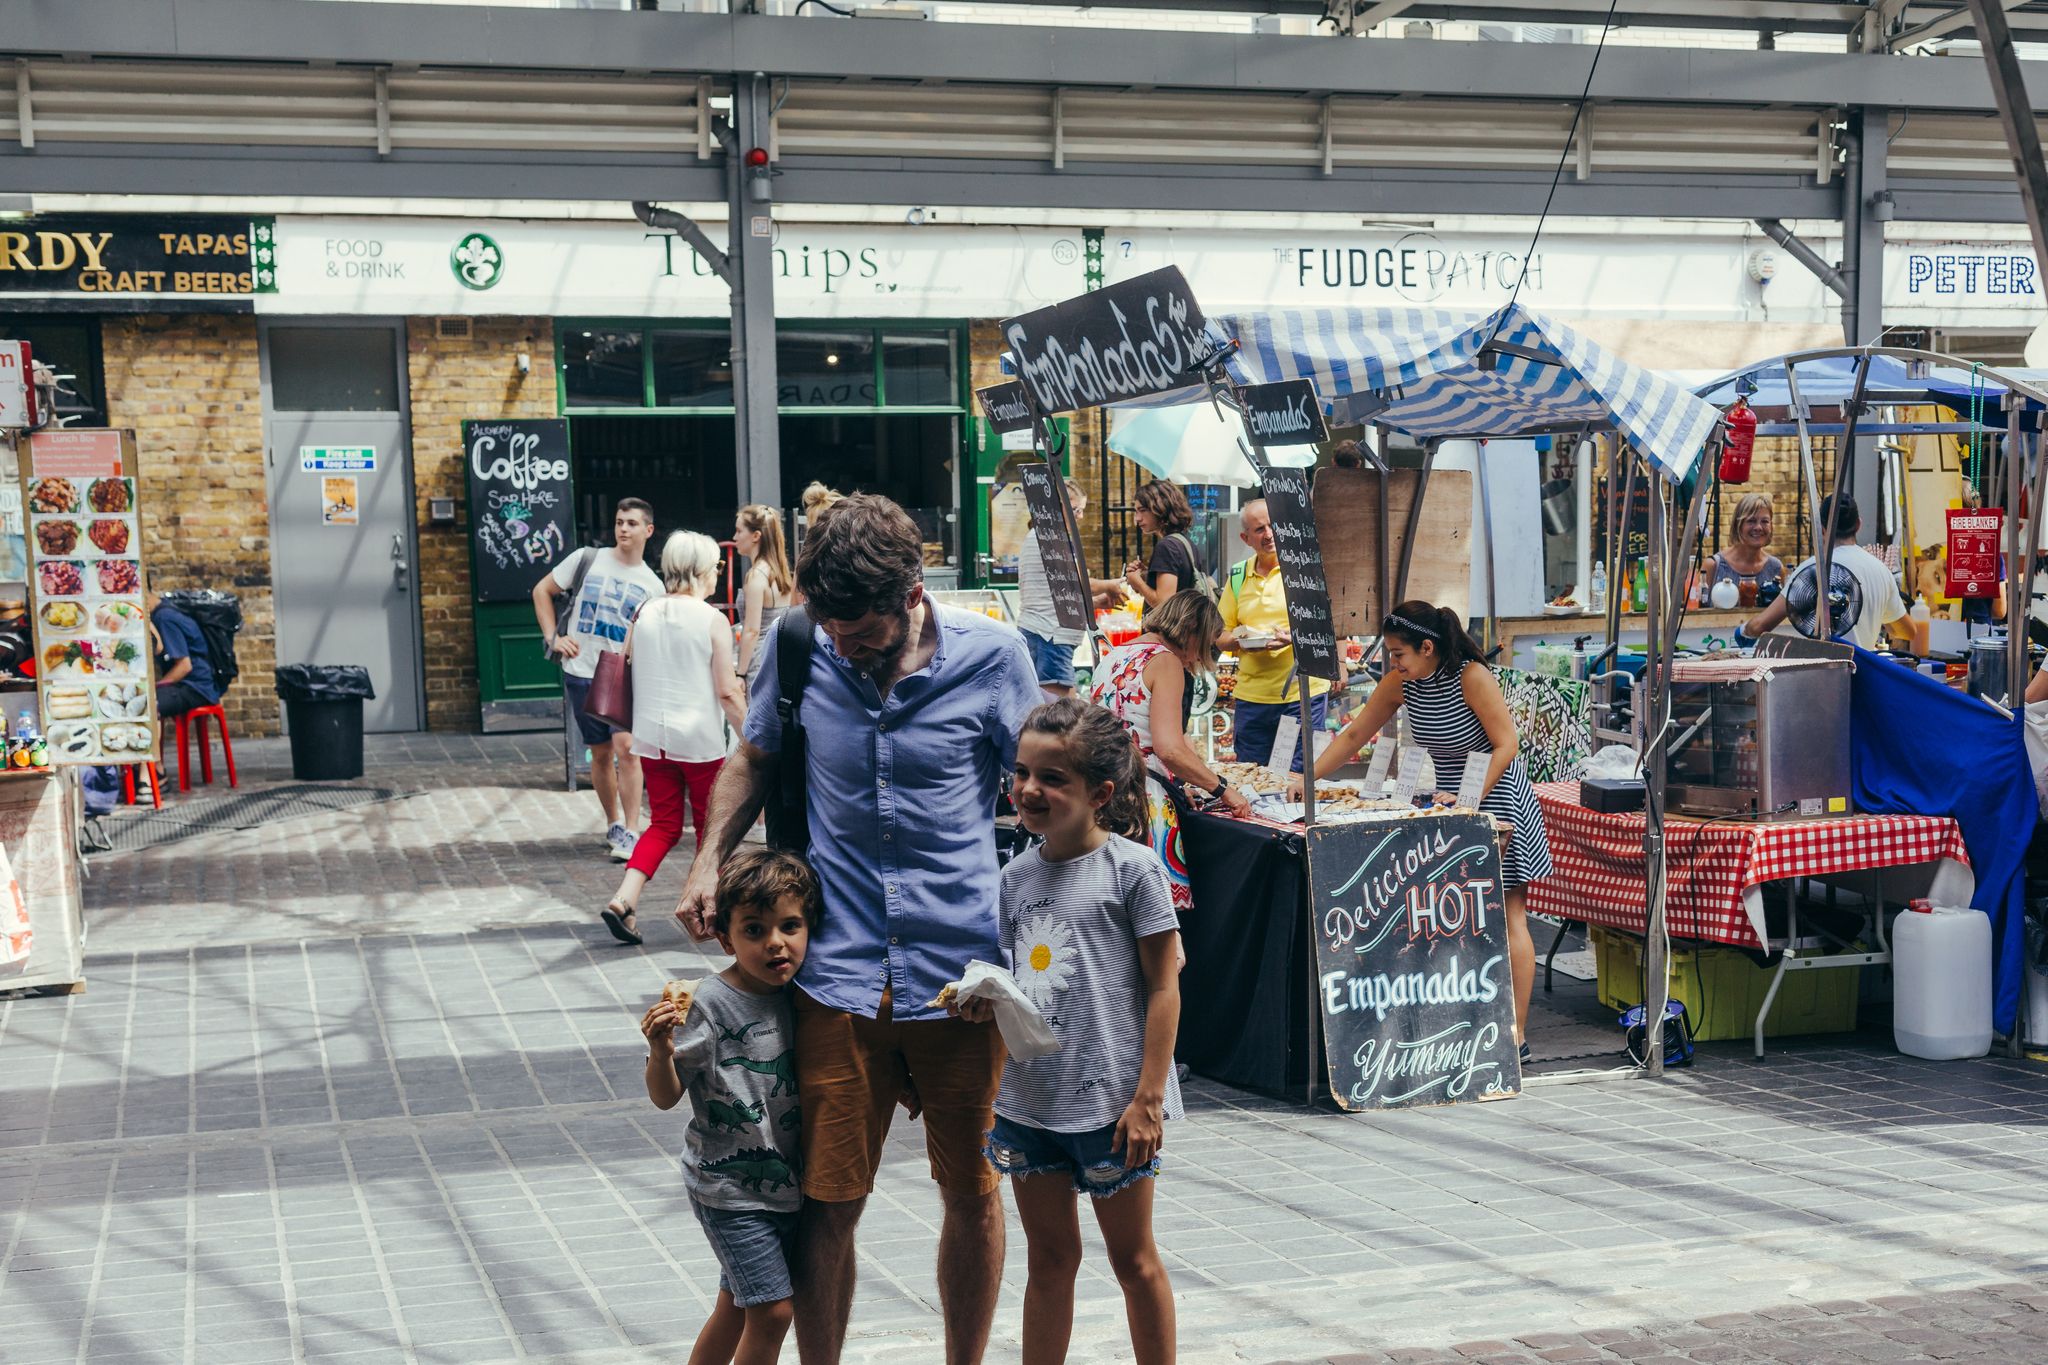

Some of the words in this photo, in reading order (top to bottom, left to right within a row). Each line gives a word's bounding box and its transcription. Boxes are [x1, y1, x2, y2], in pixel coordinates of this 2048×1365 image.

[159, 233, 248, 255] TAPAS
[326, 240, 383, 257] FOOD
[645, 234, 879, 293] Tunips
[78, 271, 165, 292] CRAFT
[174, 272, 253, 293] BEERS
[326, 262, 340, 278] &
[346, 262, 405, 279] DRINK
[1272, 247, 1294, 264] THE
[1300, 248, 1417, 288] FUDGE
[1427, 248, 1544, 290] PATCH
[1909, 255, 2036, 294] PETER
[472, 433, 569, 490] Coffee
[521, 490, 559, 510] HERE
[1952, 518, 1966, 529] FIRE
[1968, 518, 1997, 529] BLANKET
[1325, 829, 1461, 951] Delicious
[1406, 879, 1494, 942] HOT
[1351, 1022, 1498, 1103] Yummy
